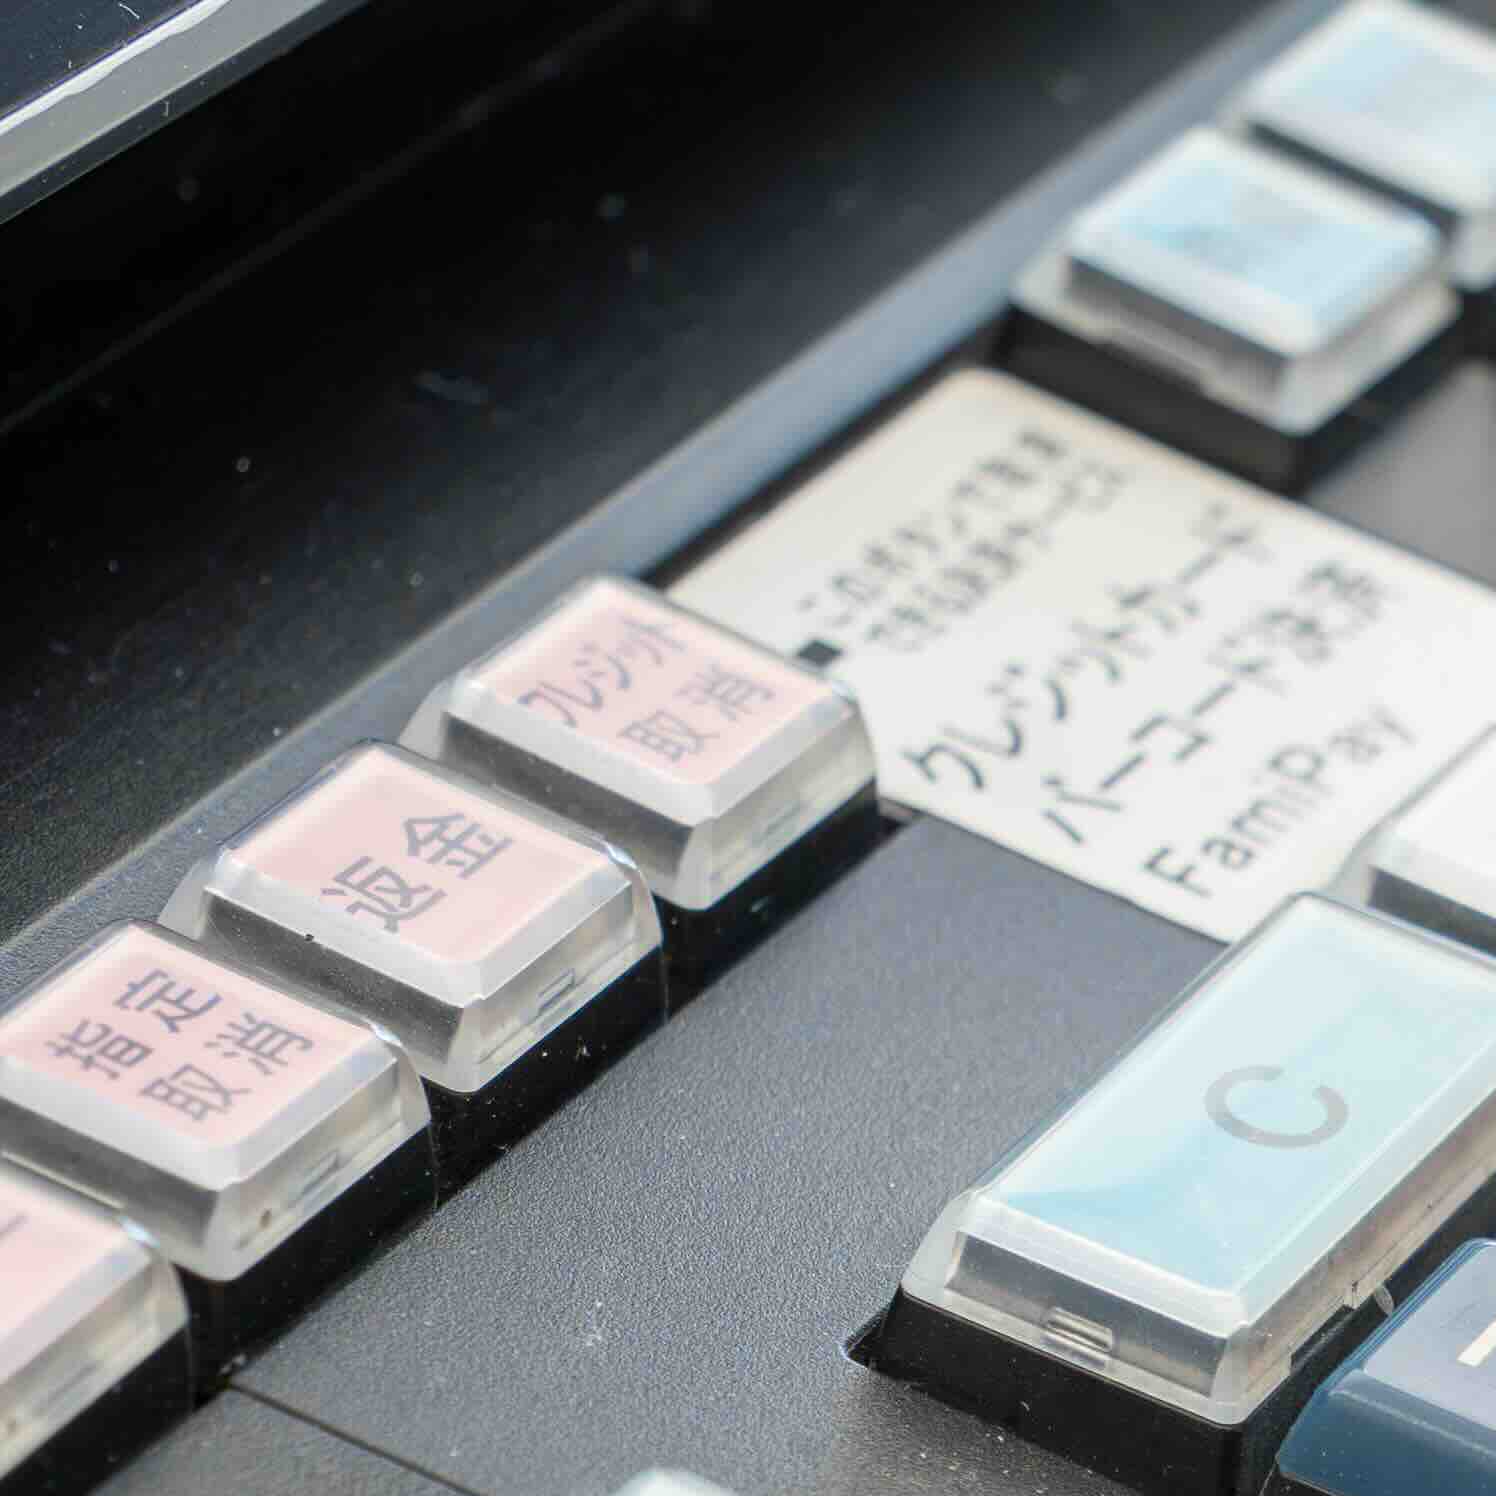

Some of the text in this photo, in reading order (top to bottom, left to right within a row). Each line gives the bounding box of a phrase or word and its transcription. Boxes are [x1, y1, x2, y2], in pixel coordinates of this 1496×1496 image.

[898, 498, 1274, 796] クレジットカード
[614, 656, 778, 763] 取消
[1142, 703, 1418, 898] FamiPay
[320, 809, 513, 934] 返金
[44, 967, 223, 1082] 指定
[137, 1010, 316, 1123] 取消
[1204, 1064, 1350, 1149] C
